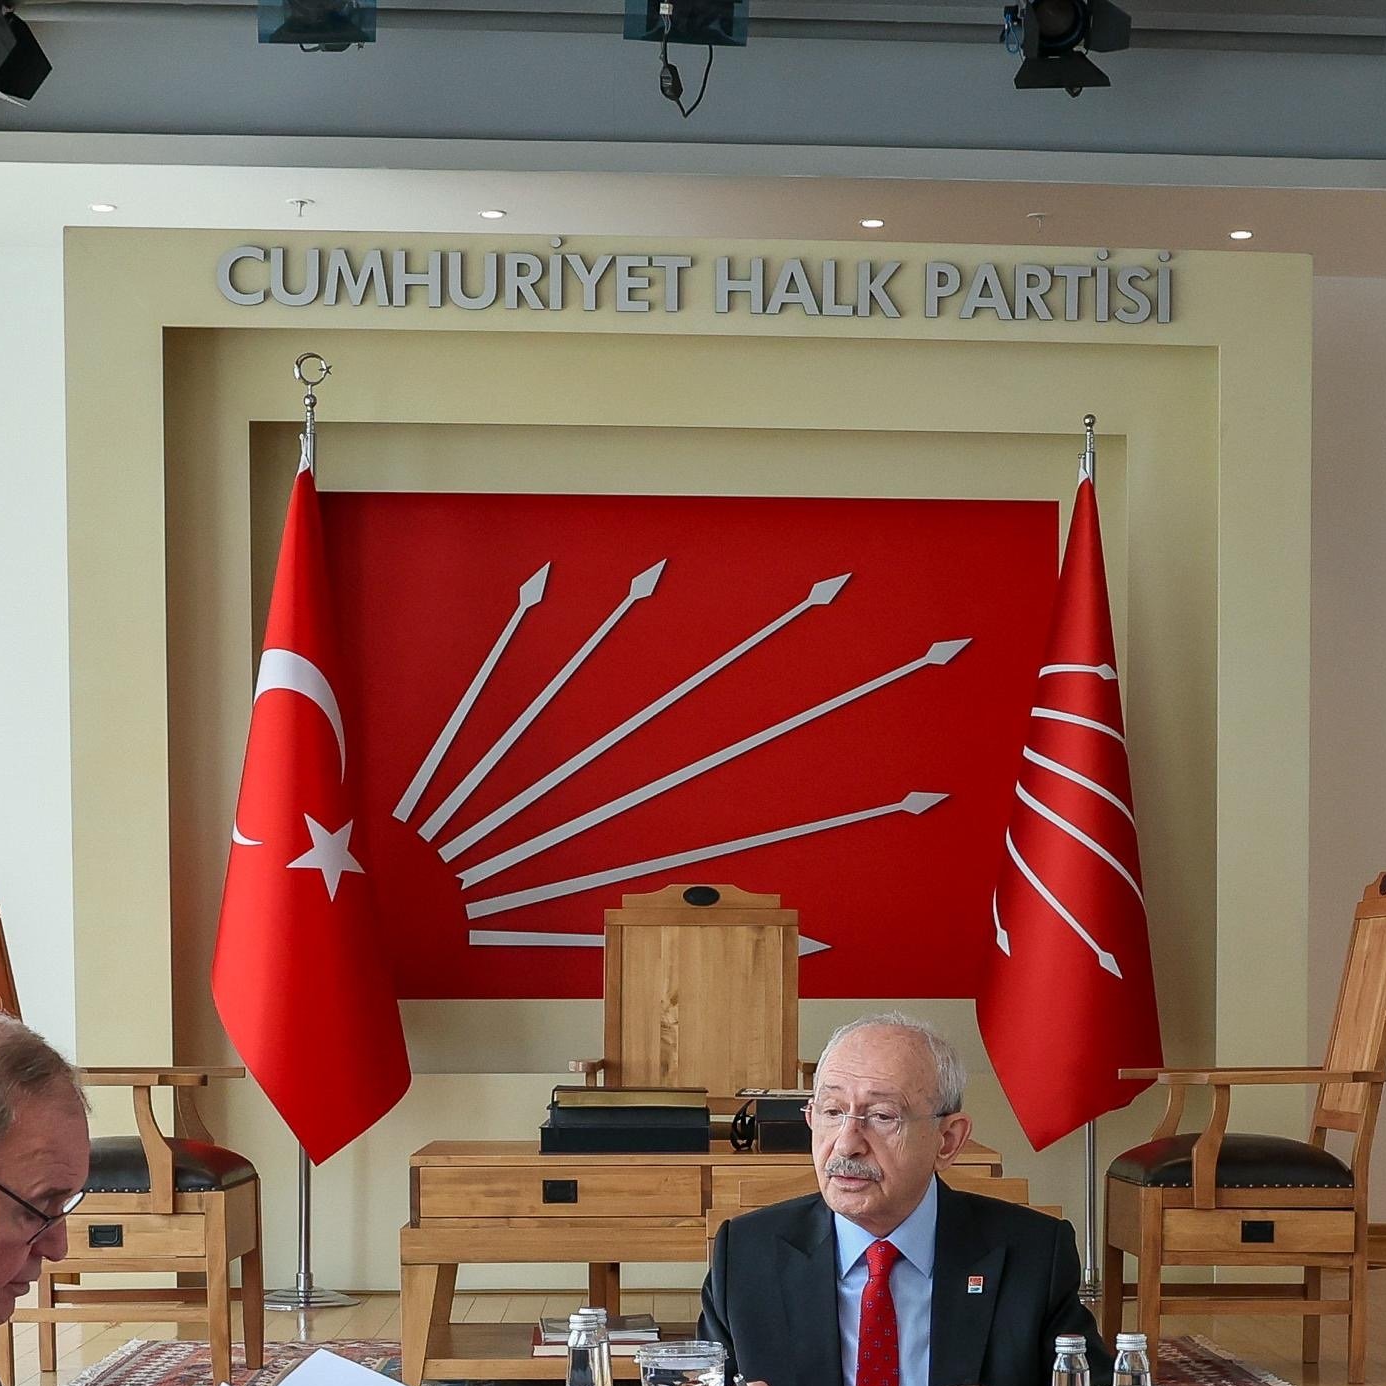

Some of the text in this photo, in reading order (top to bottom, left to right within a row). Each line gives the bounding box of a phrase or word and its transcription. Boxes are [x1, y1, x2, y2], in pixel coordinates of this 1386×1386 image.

[217, 237, 1172, 324] CUMHURİYET HALK PARTİSİ
